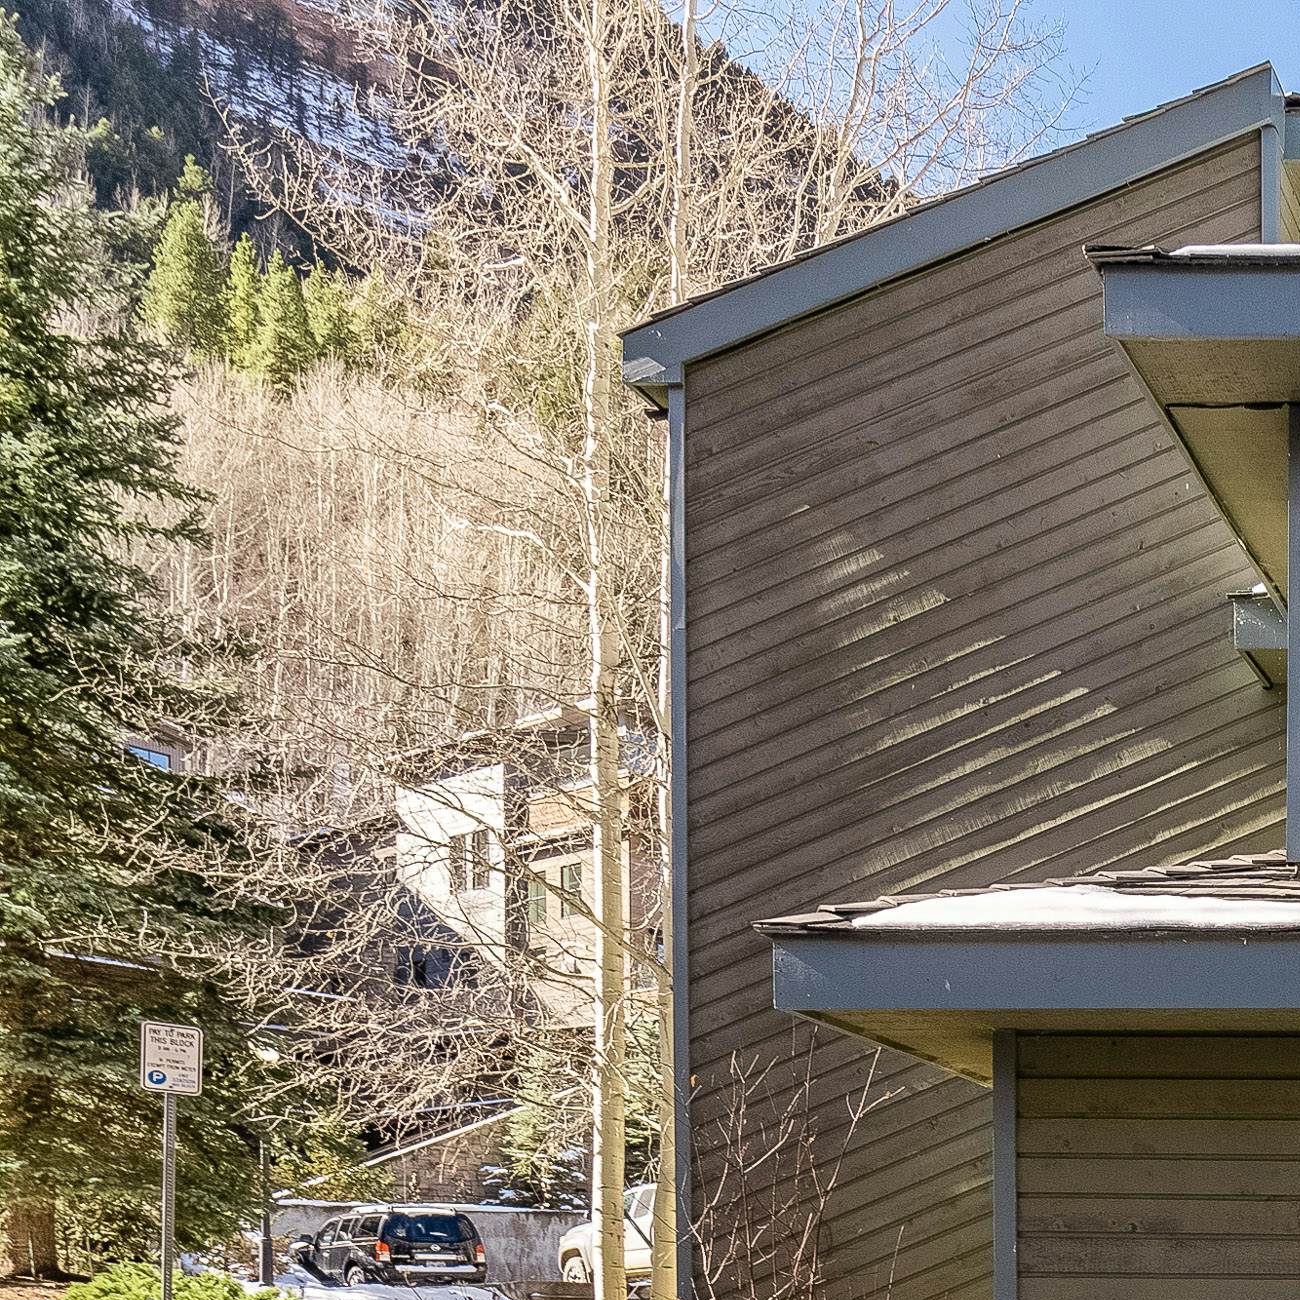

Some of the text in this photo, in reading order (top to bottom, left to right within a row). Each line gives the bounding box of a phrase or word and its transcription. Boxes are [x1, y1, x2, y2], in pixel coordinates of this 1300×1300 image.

[149, 1028, 161, 1036] PAY
[177, 1031, 196, 1040] PARK
[150, 1036, 194, 1048] THIS BLOCK
